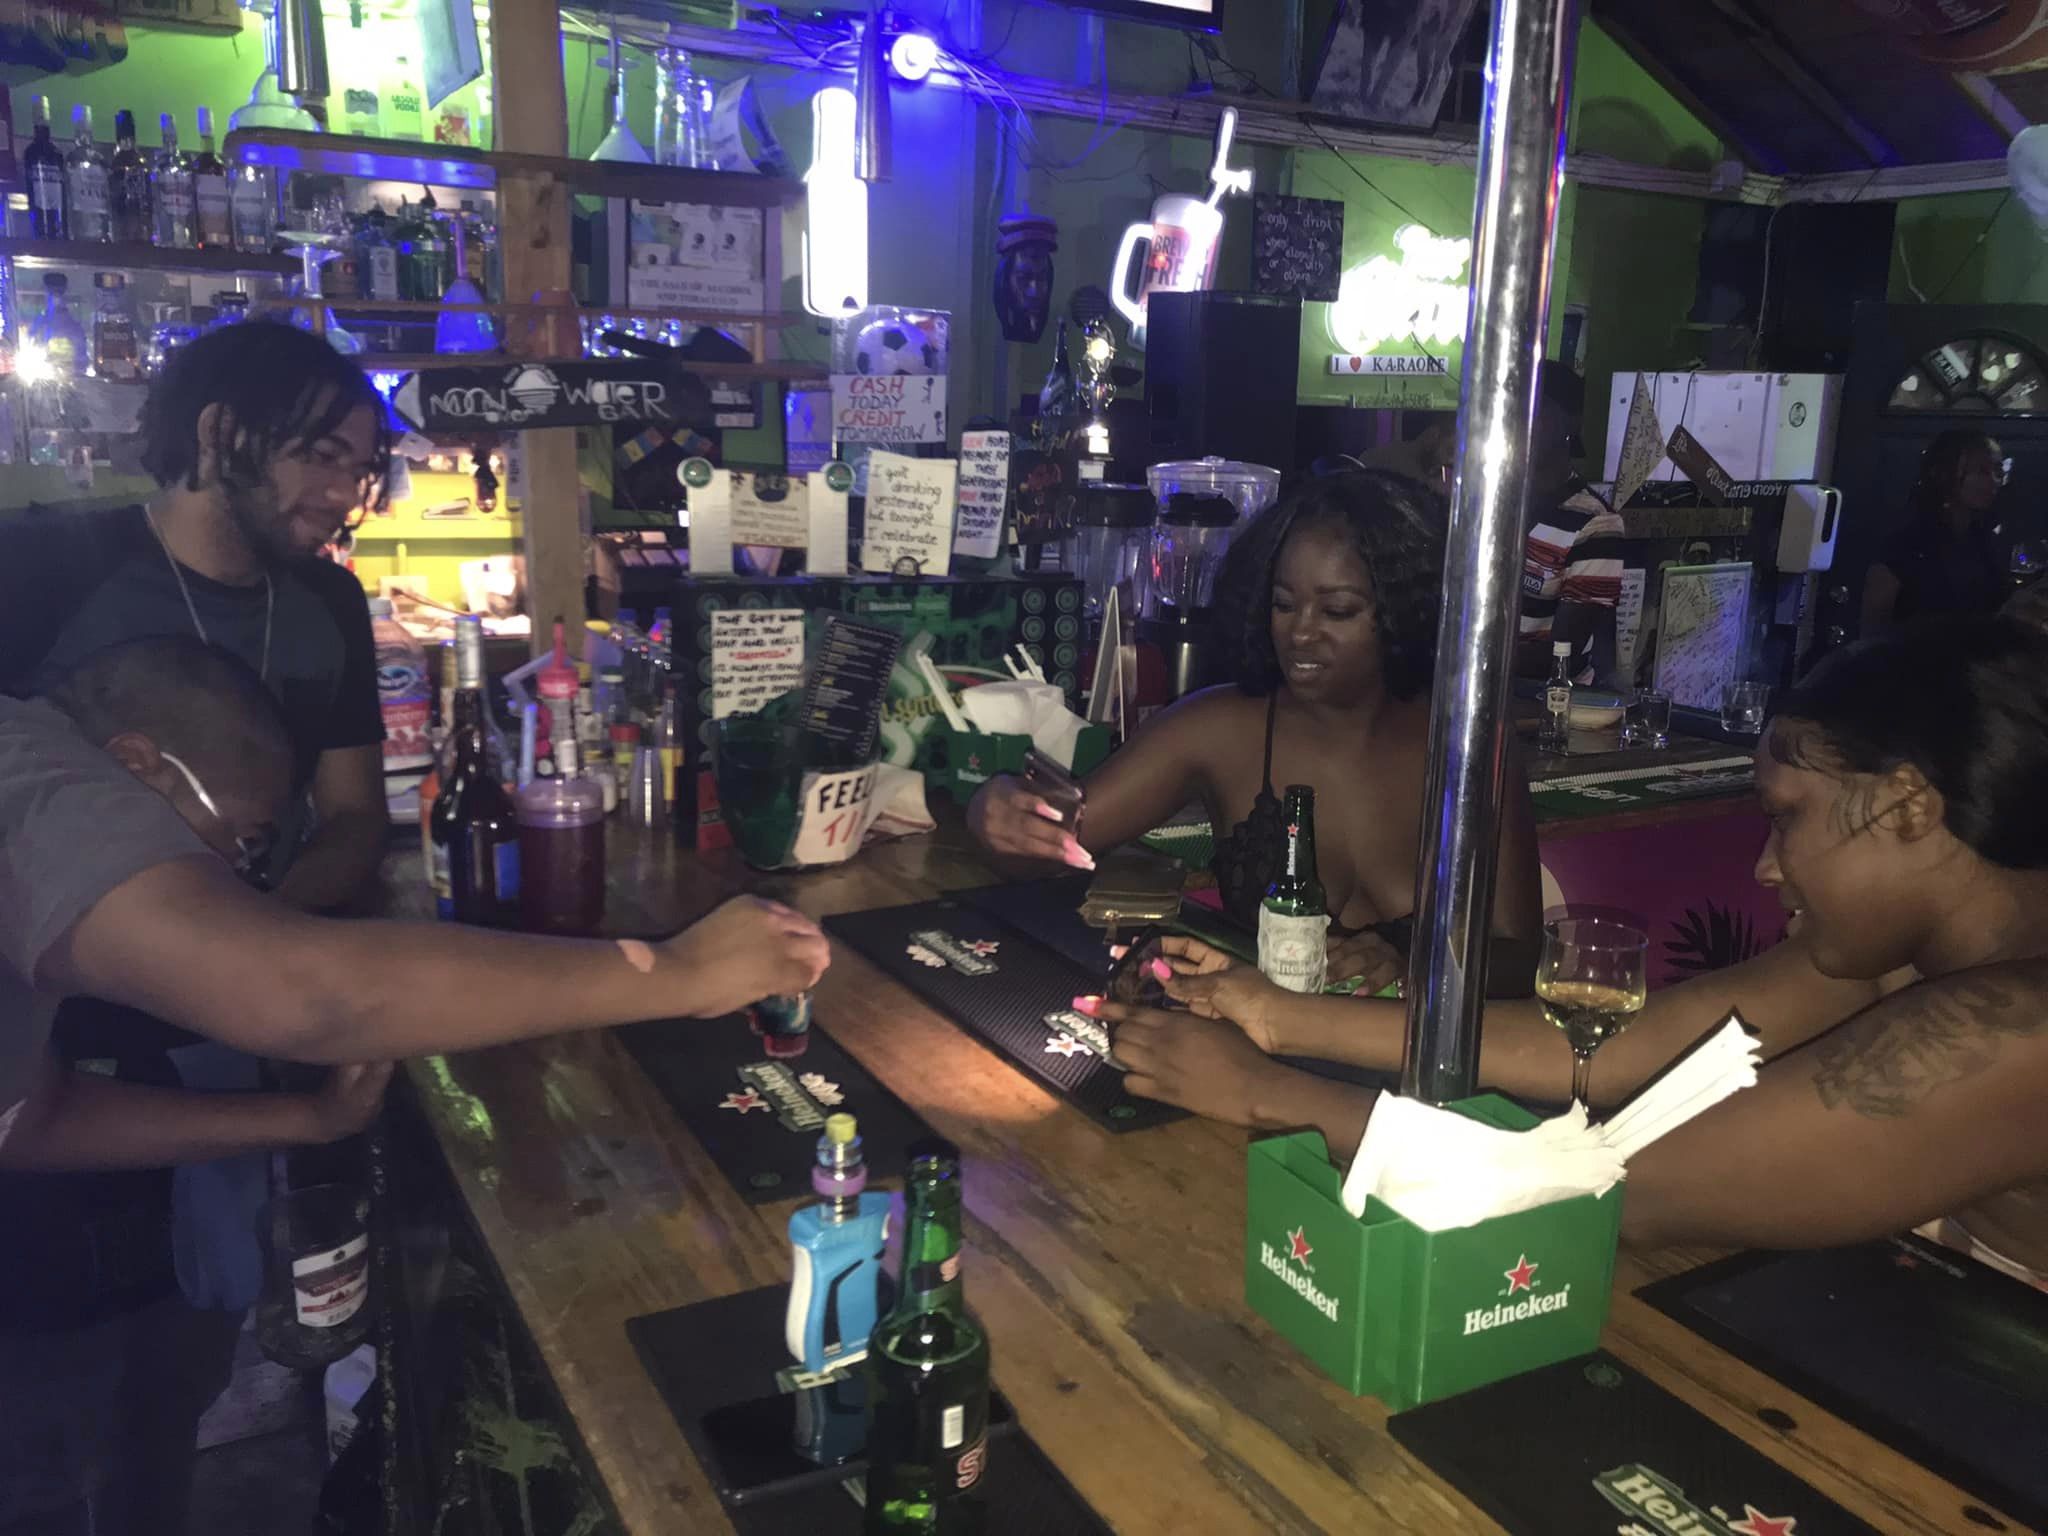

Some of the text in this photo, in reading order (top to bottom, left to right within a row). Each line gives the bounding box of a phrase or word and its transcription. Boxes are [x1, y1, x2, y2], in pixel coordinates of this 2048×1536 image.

[1266, 213, 1289, 232] only
[1334, 357, 1446, 373] I KARAOKE
[849, 376, 905, 394] CASH
[848, 395, 904, 410] TODAY
[840, 408, 906, 427] CREDIT
[836, 424, 926, 441] TOMORROW
[891, 480, 943, 505] drinking
[873, 496, 935, 512] yesterday
[867, 509, 935, 529] but tonight
[881, 529, 939, 546] celebrate
[1261, 1241, 1339, 1322] Heineken
[1463, 1288, 1569, 1336] Heineken
